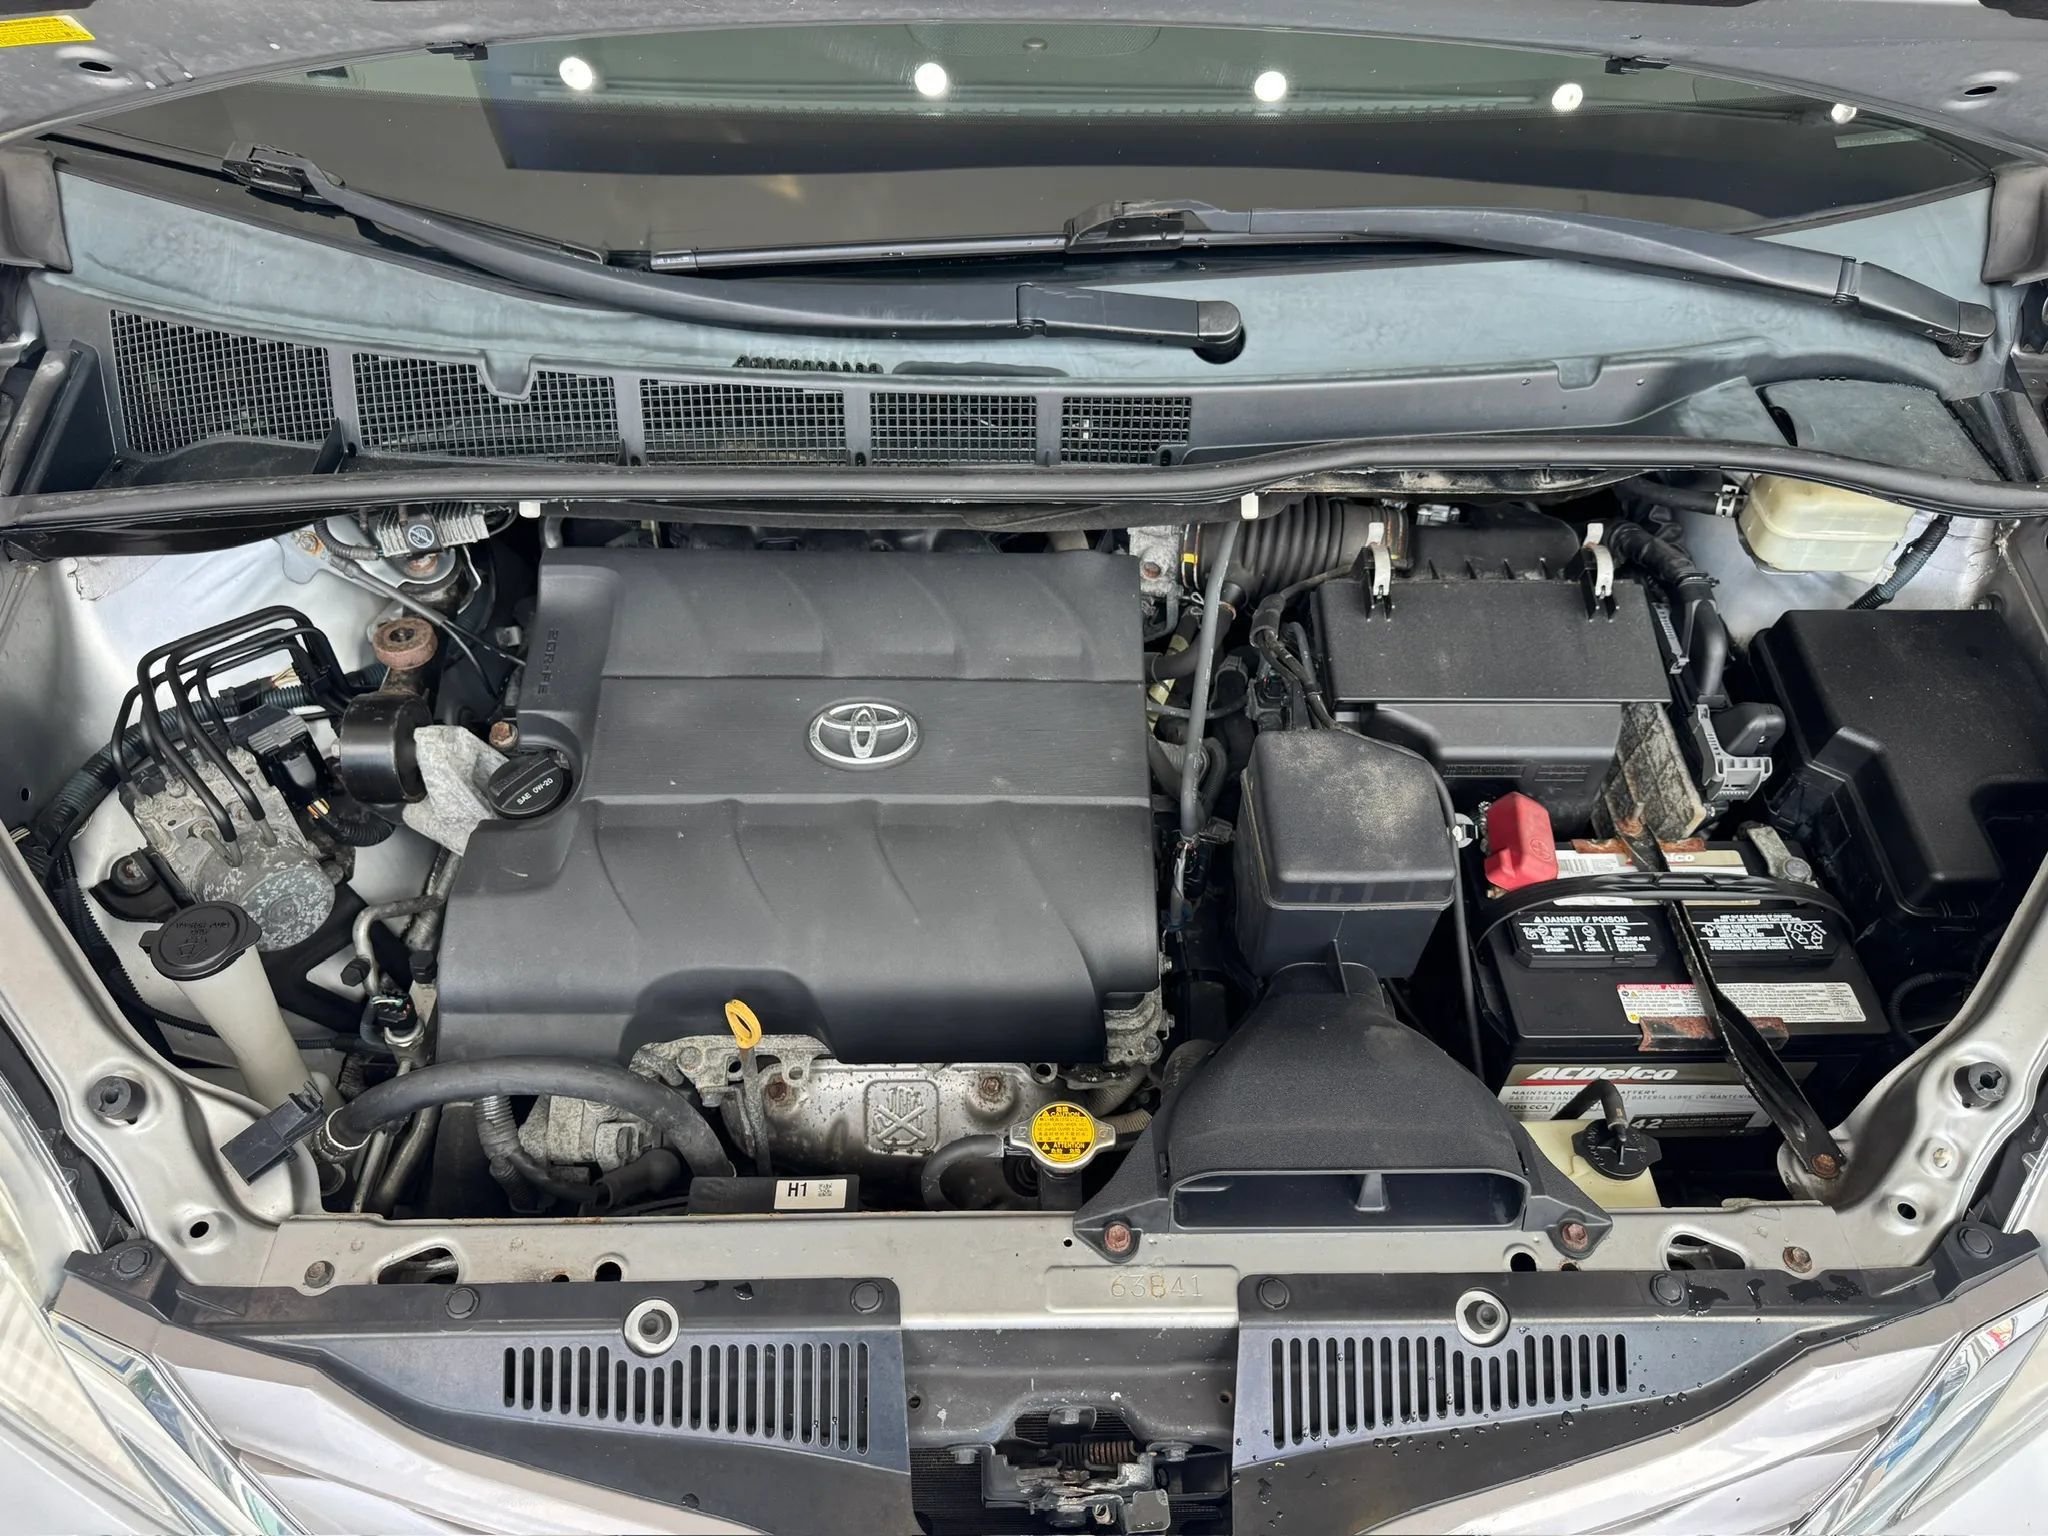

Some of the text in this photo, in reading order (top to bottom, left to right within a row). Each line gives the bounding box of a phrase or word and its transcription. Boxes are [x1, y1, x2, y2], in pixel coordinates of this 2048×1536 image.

[516, 777, 554, 805] SAE 0W-20
[1591, 915, 1629, 923] POISON
[1526, 1066, 1678, 1081] ACDelco
[1631, 1118, 1662, 1129] 42
[787, 1182, 808, 1197] H1
[1111, 1273, 1203, 1298] 63841
